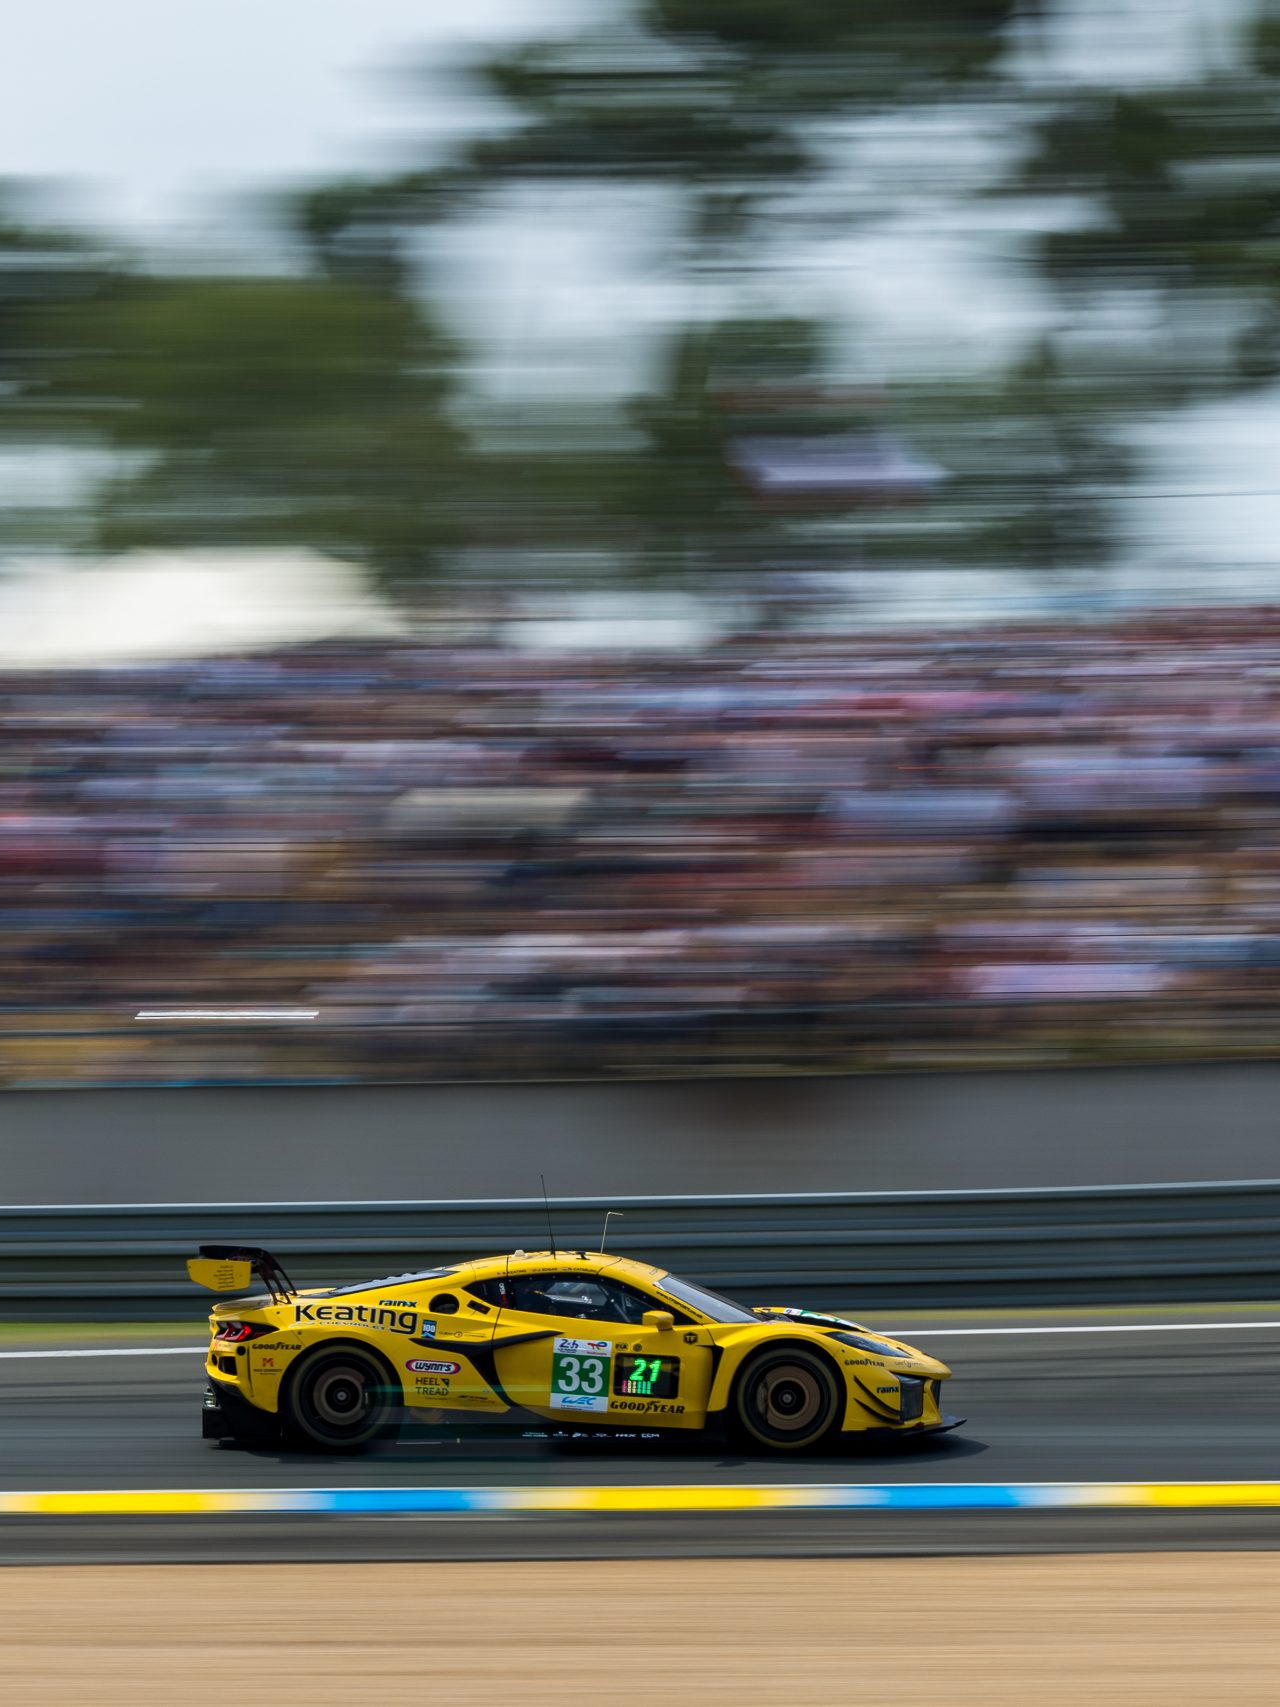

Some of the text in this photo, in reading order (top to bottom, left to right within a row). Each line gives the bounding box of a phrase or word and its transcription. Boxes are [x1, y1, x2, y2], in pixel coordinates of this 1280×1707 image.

[295, 1304, 418, 1335] Keating
[423, 1324, 436, 1333] 100
[252, 1342, 302, 1350] GOODYEAR
[558, 1356, 604, 1394] 33
[629, 1358, 662, 1382] 21
[416, 1377, 440, 1386] HEEL
[415, 1386, 449, 1396] TREAD
[561, 1396, 598, 1406] WEC
[610, 1400, 685, 1414] GOODYEAR
